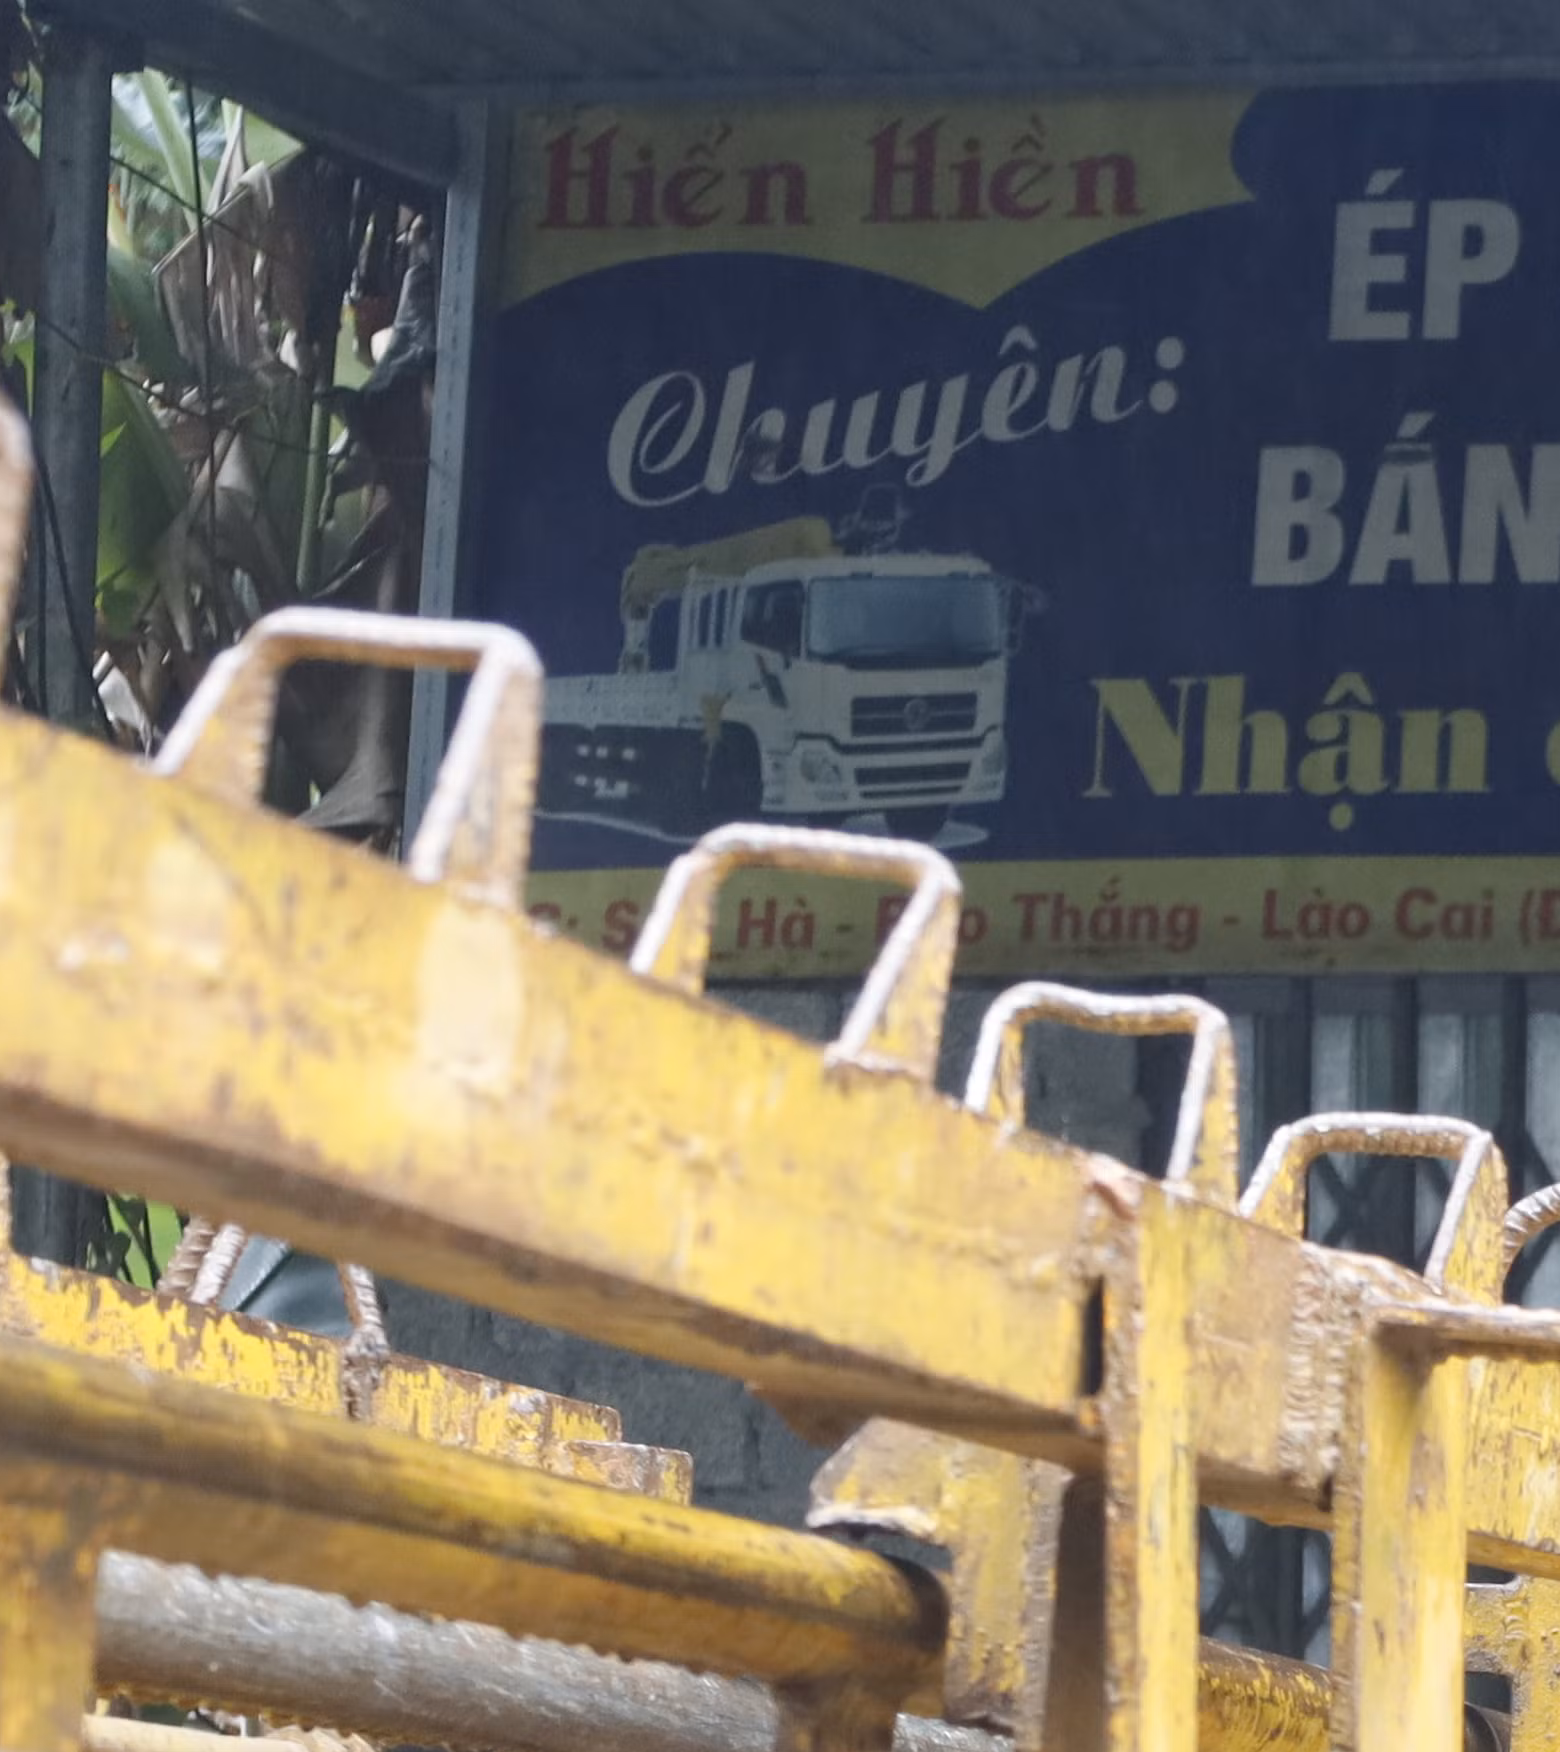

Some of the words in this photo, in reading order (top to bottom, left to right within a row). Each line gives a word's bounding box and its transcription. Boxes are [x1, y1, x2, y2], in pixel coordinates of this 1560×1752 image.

[1328, 168, 1521, 341] ÉP
[607, 324, 1186, 508] Chuyên:
[1082, 671, 1490, 830] Nhận
[739, 895, 816, 950] Hà
[1013, 875, 1202, 953] Thắng
[1262, 887, 1370, 941] Lào
[1395, 888, 1495, 941] Cai
